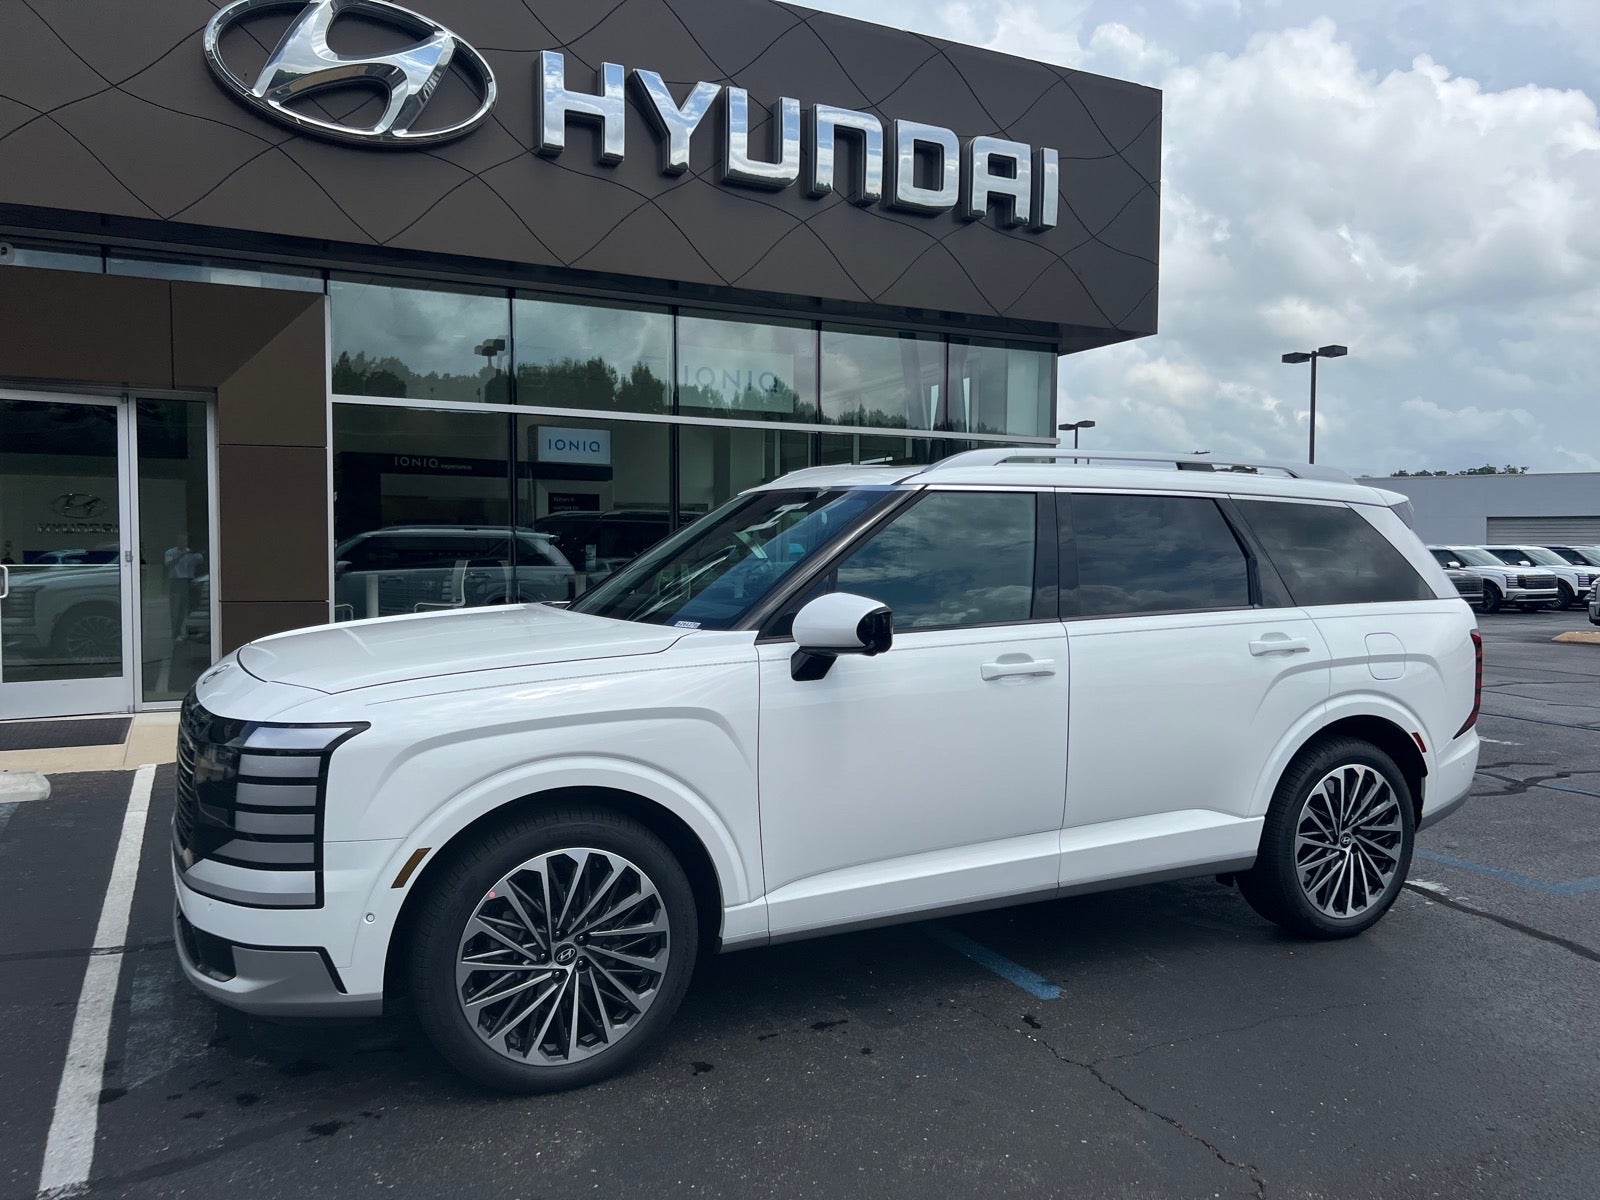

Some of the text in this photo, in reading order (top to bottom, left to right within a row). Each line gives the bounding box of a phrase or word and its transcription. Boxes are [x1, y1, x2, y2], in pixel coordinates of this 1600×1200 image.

[539, 50, 1059, 230] HYUNDAI
[684, 365, 778, 393] IONIQ
[548, 438, 601, 453] IONIQ
[394, 455, 439, 468] IONIQ
